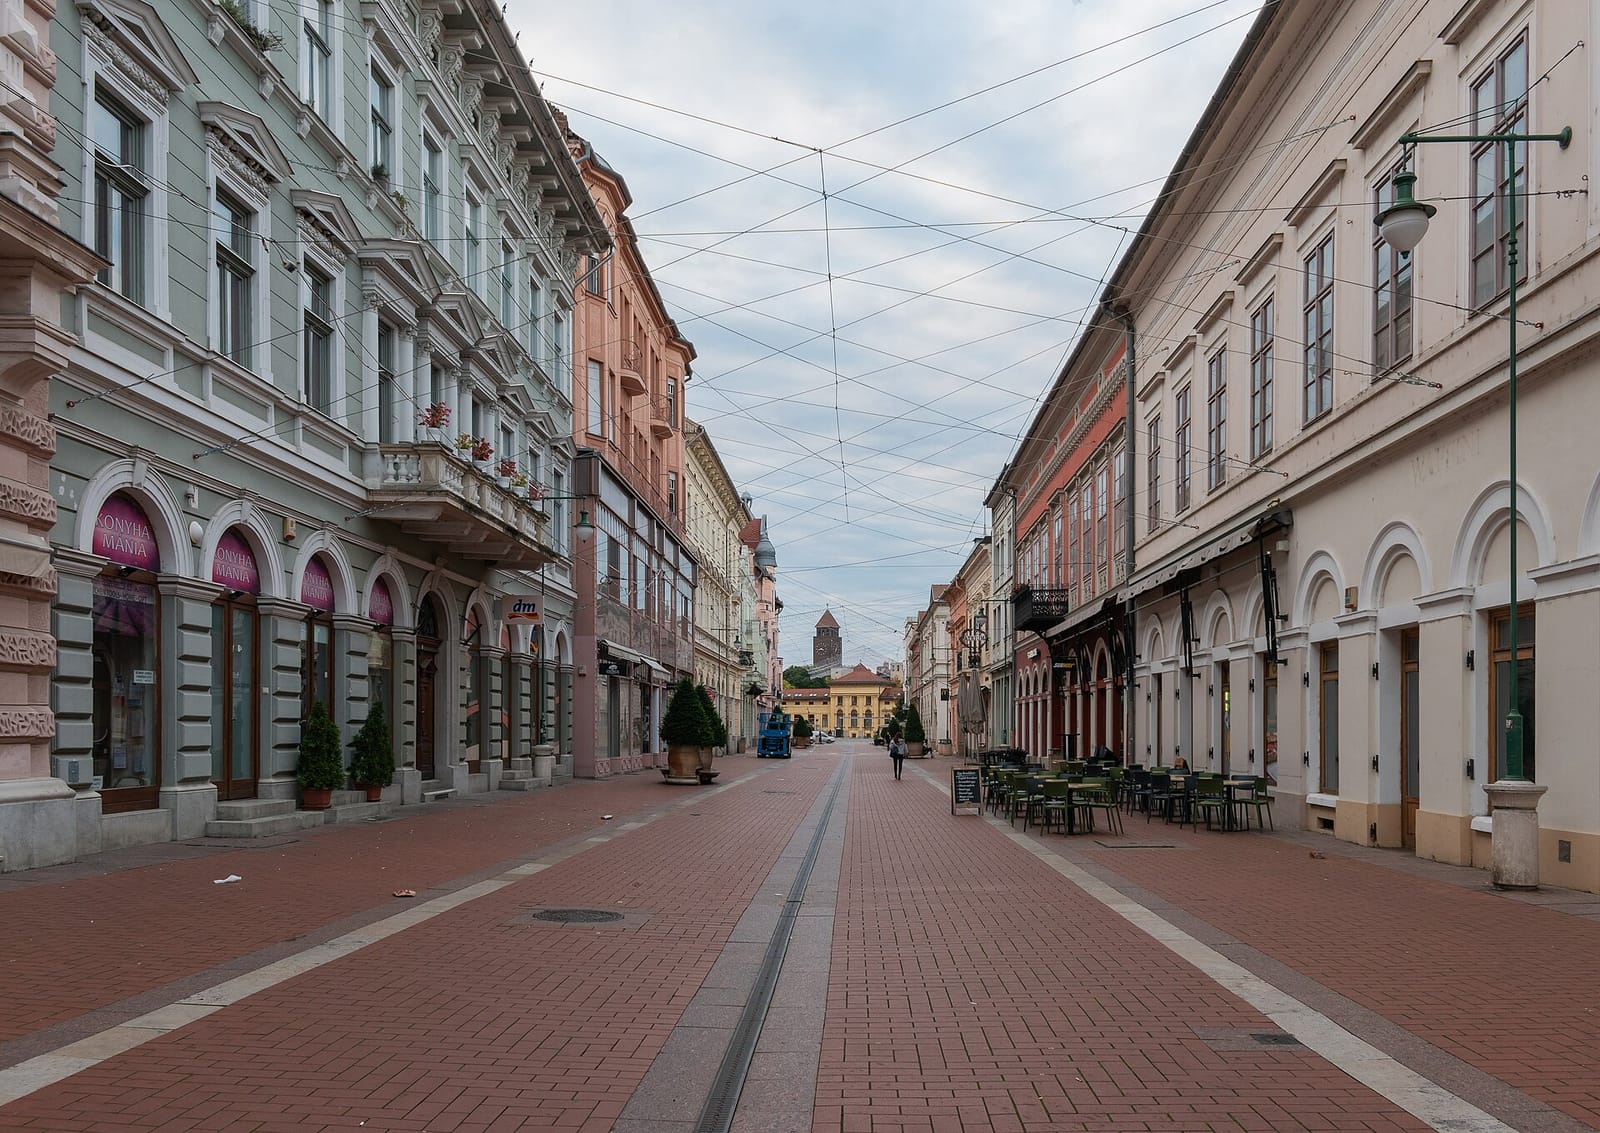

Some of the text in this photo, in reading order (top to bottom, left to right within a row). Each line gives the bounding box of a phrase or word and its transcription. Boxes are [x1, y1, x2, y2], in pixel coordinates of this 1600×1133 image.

[96, 513, 150, 540] KONYHA
[215, 547, 253, 569] ONYHA
[513, 599, 536, 613] dm
